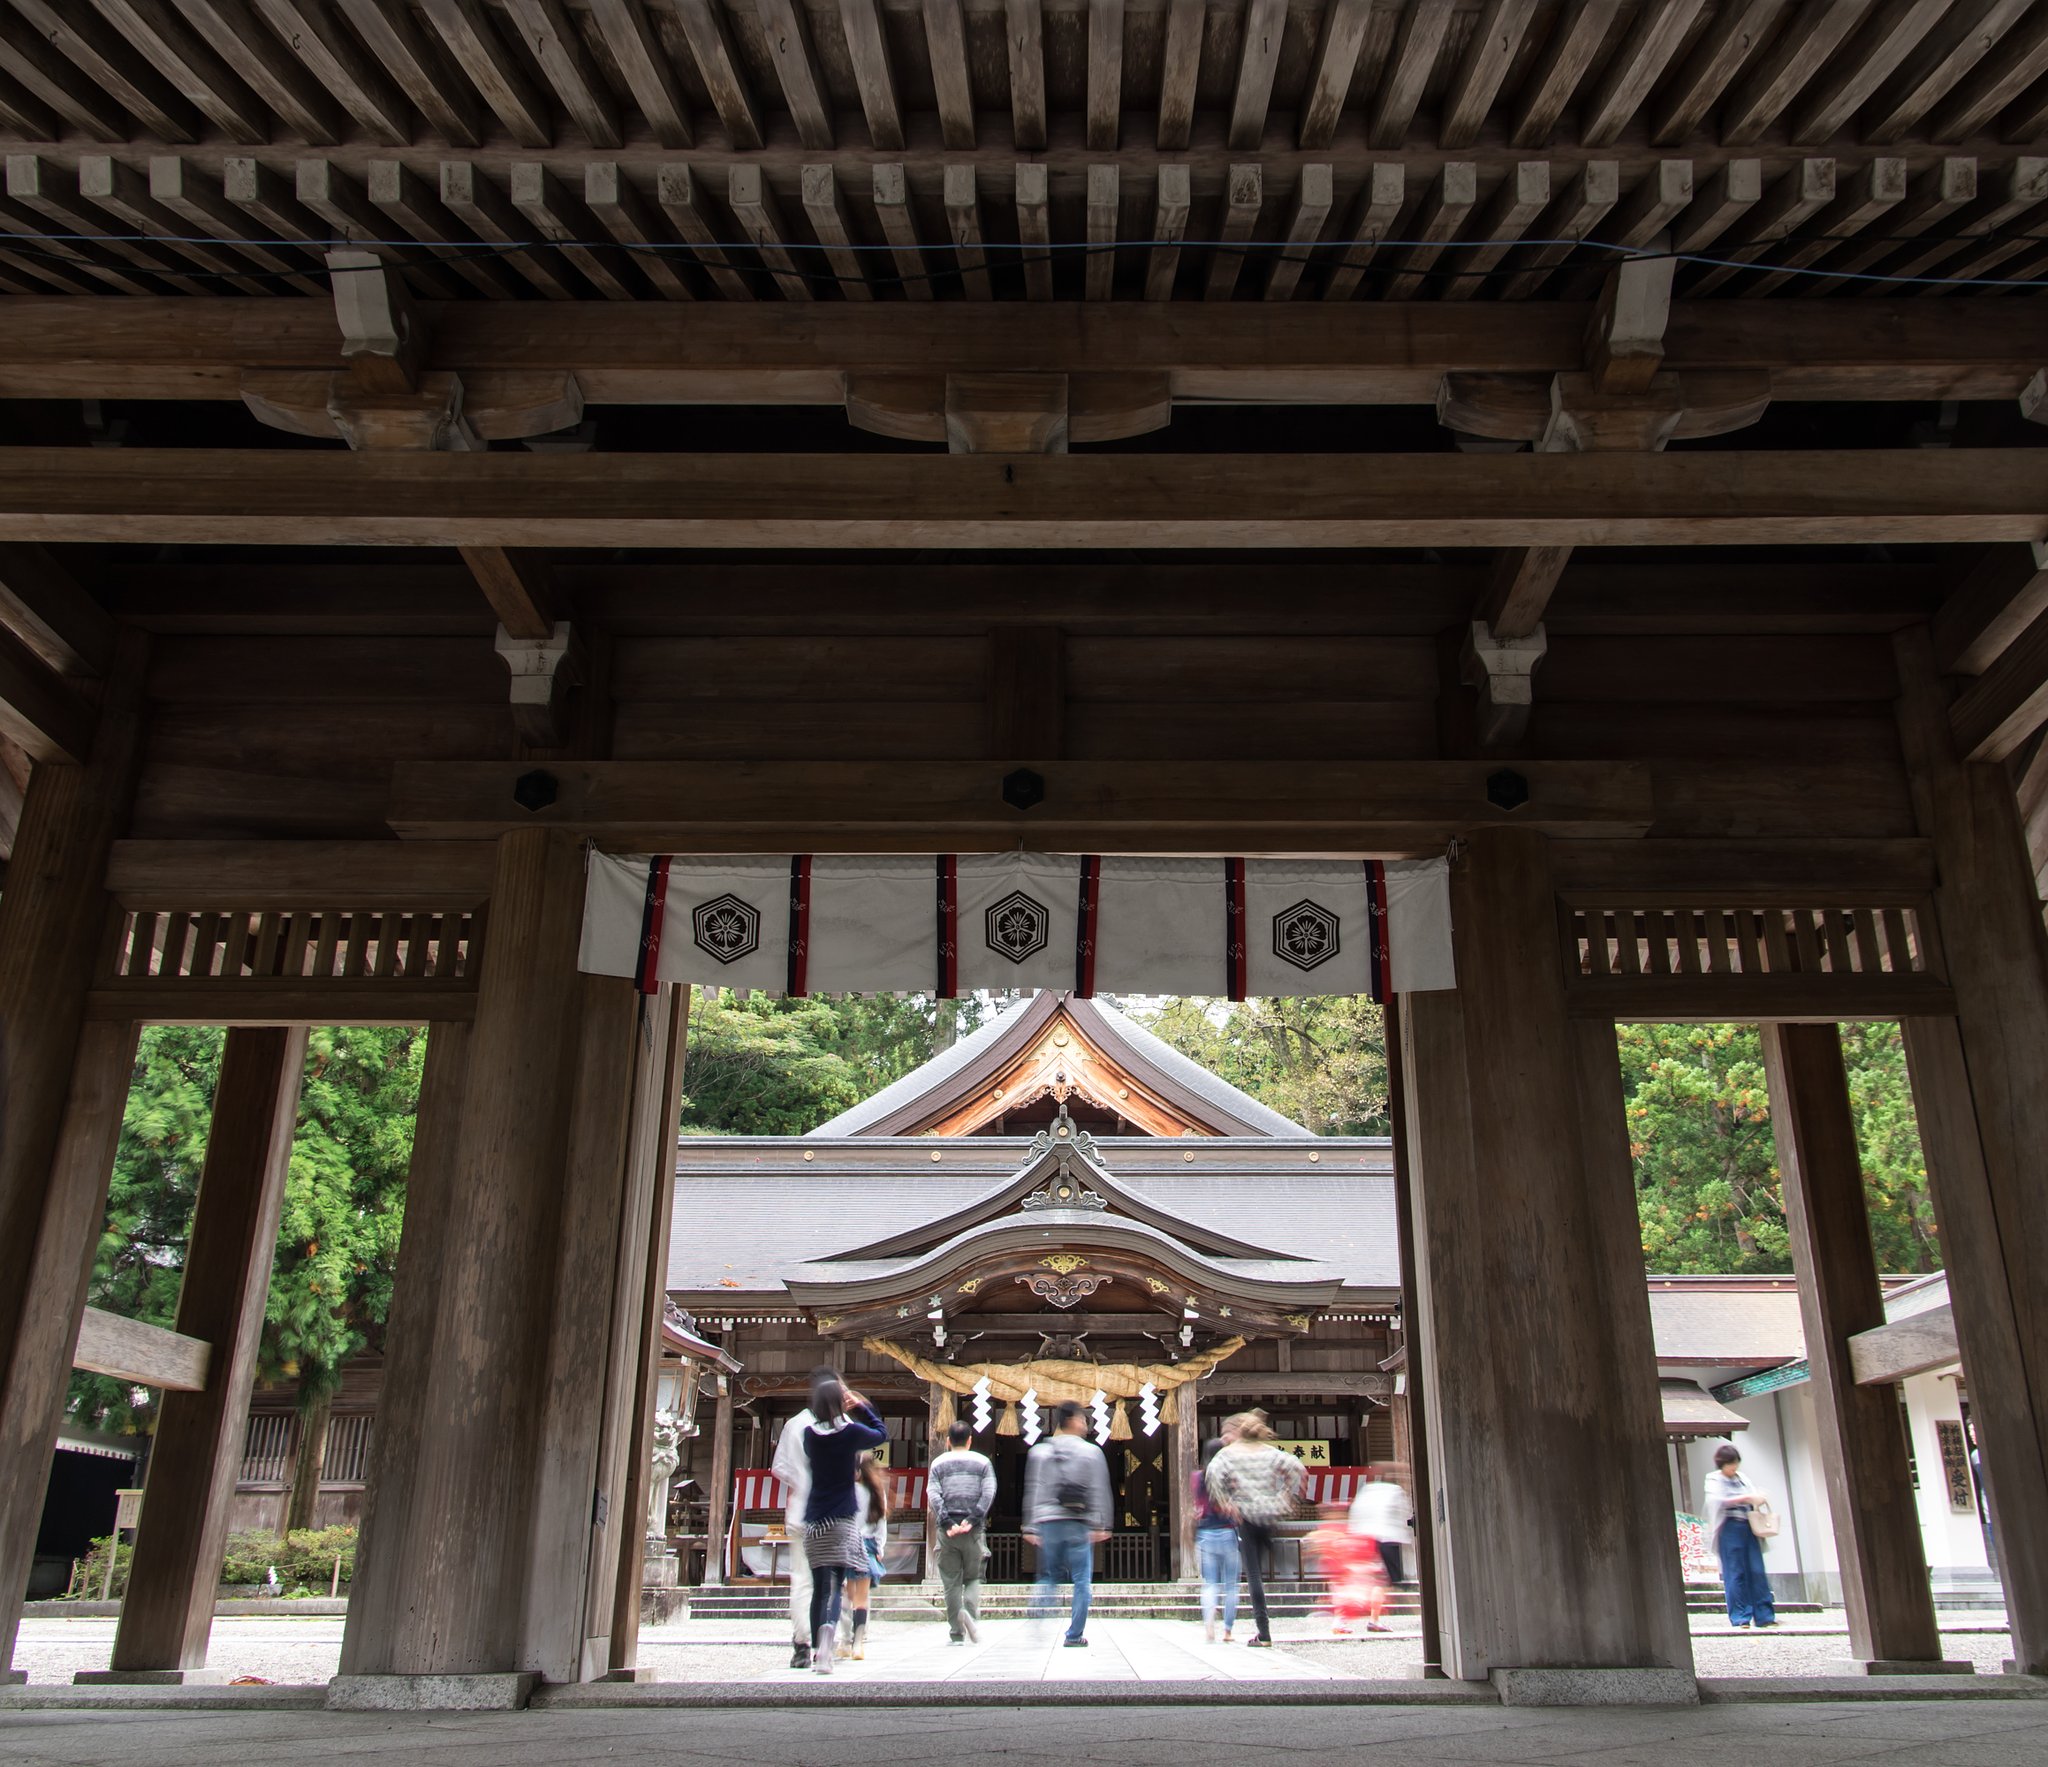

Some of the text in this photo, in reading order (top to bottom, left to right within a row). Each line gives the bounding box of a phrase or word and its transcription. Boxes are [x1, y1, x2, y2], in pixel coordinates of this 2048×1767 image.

[1277, 1445, 1326, 1459] 奉献
[1952, 1468, 1969, 1506] 受付
[1679, 1529, 1691, 1582] おめでと
[1691, 1523, 1704, 1558] 七五三
